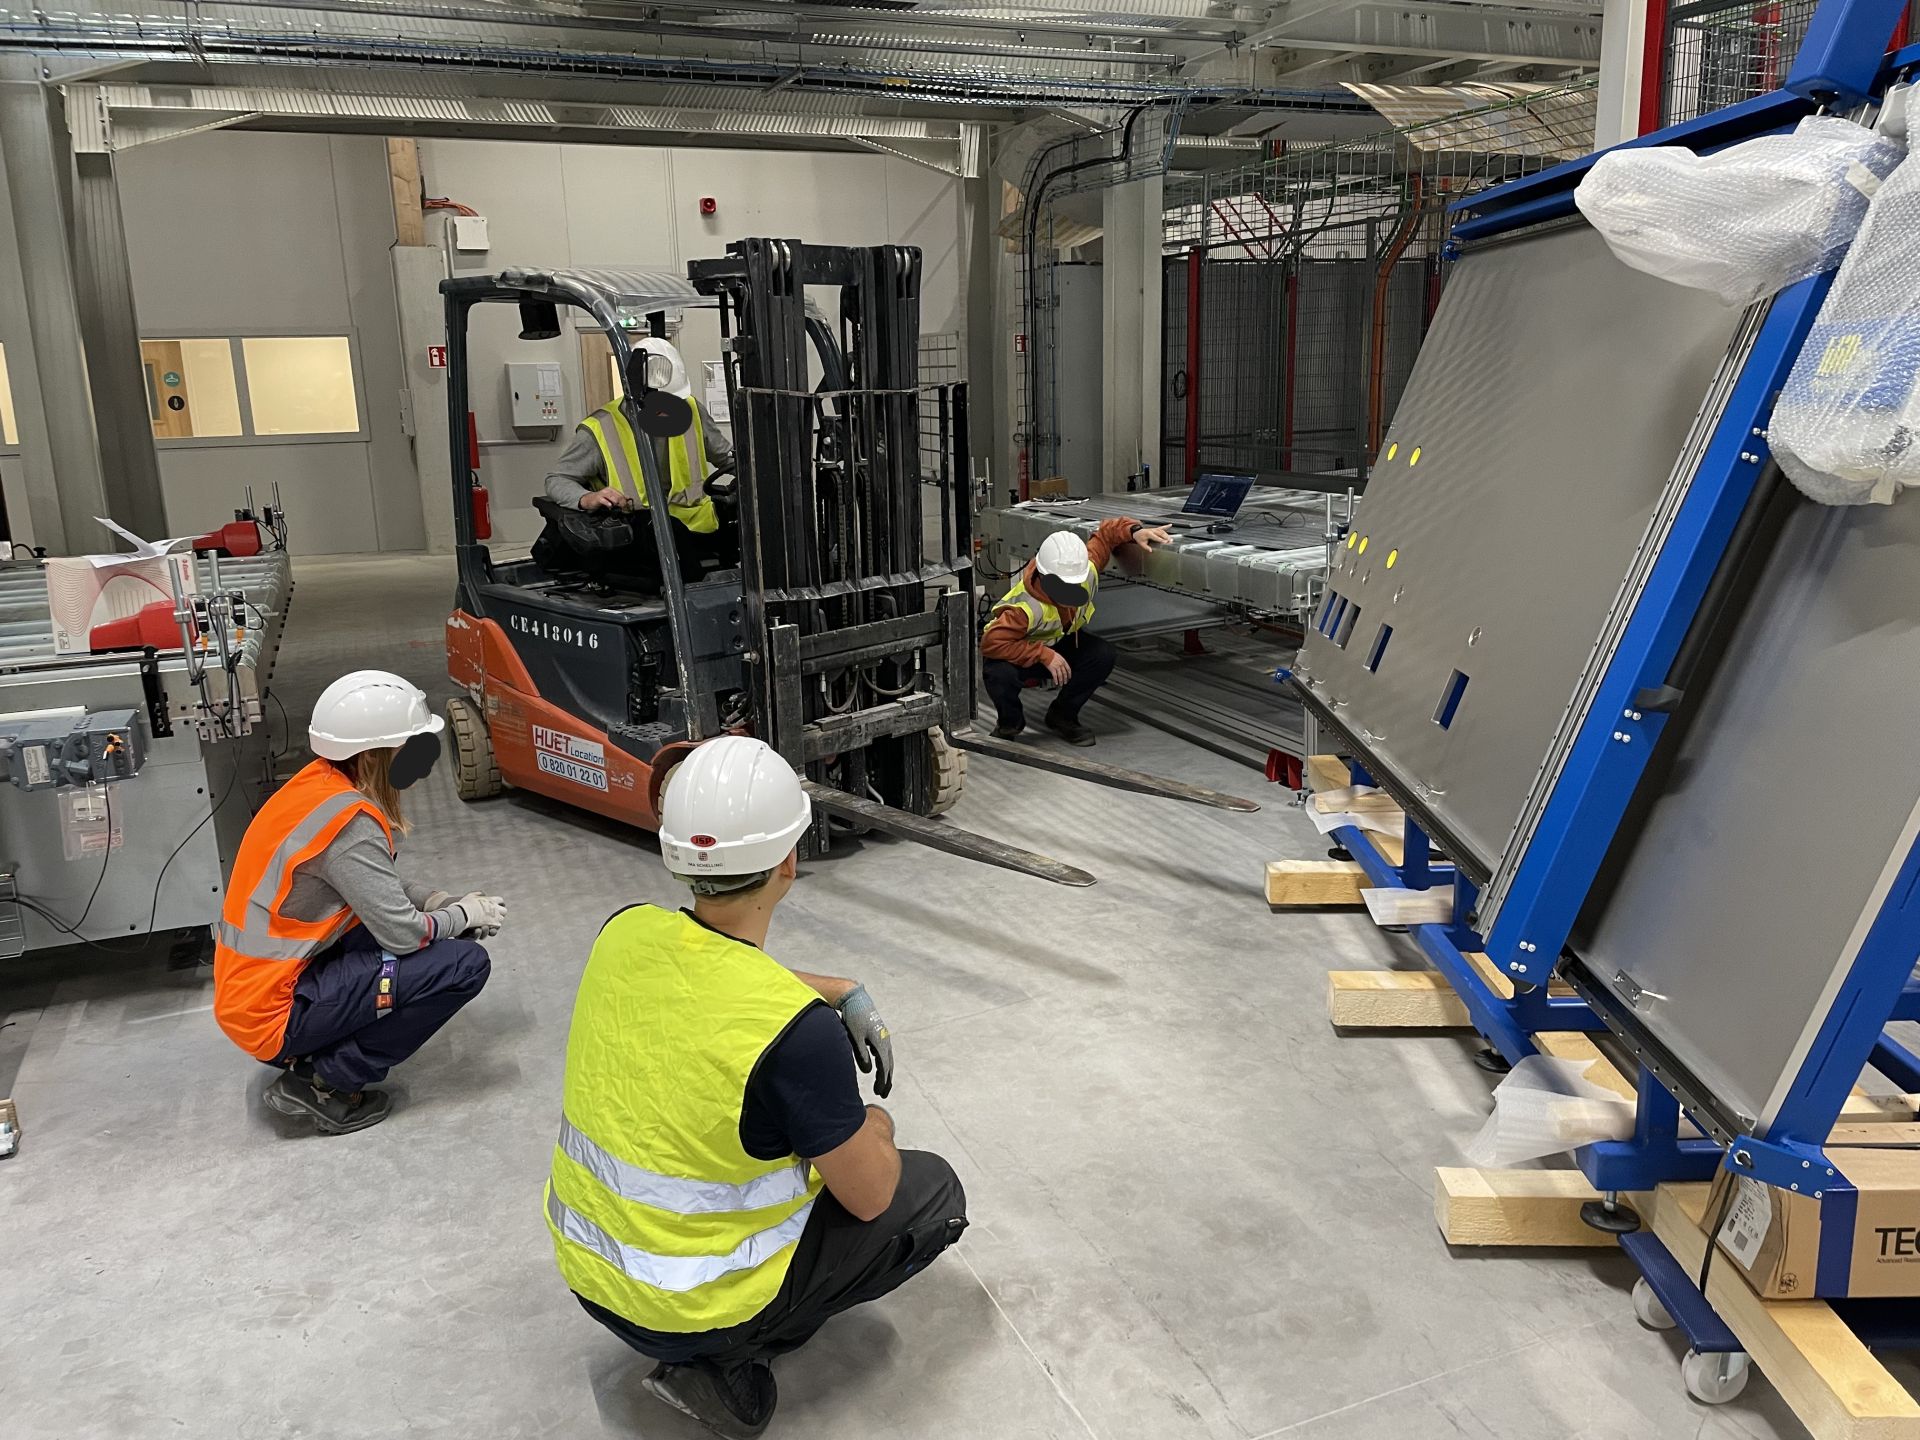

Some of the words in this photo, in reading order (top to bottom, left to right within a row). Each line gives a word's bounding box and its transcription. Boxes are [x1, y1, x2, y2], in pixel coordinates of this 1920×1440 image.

[510, 614, 599, 649] CE418016
[535, 727, 571, 754] HUET
[570, 746, 604, 765] Location
[542, 756, 548, 769] 0
[549, 758, 565, 774] 820
[567, 765, 577, 778] 01
[580, 769, 591, 783] 22
[593, 773, 603, 787] 01
[1875, 1227, 1920, 1256] TE
